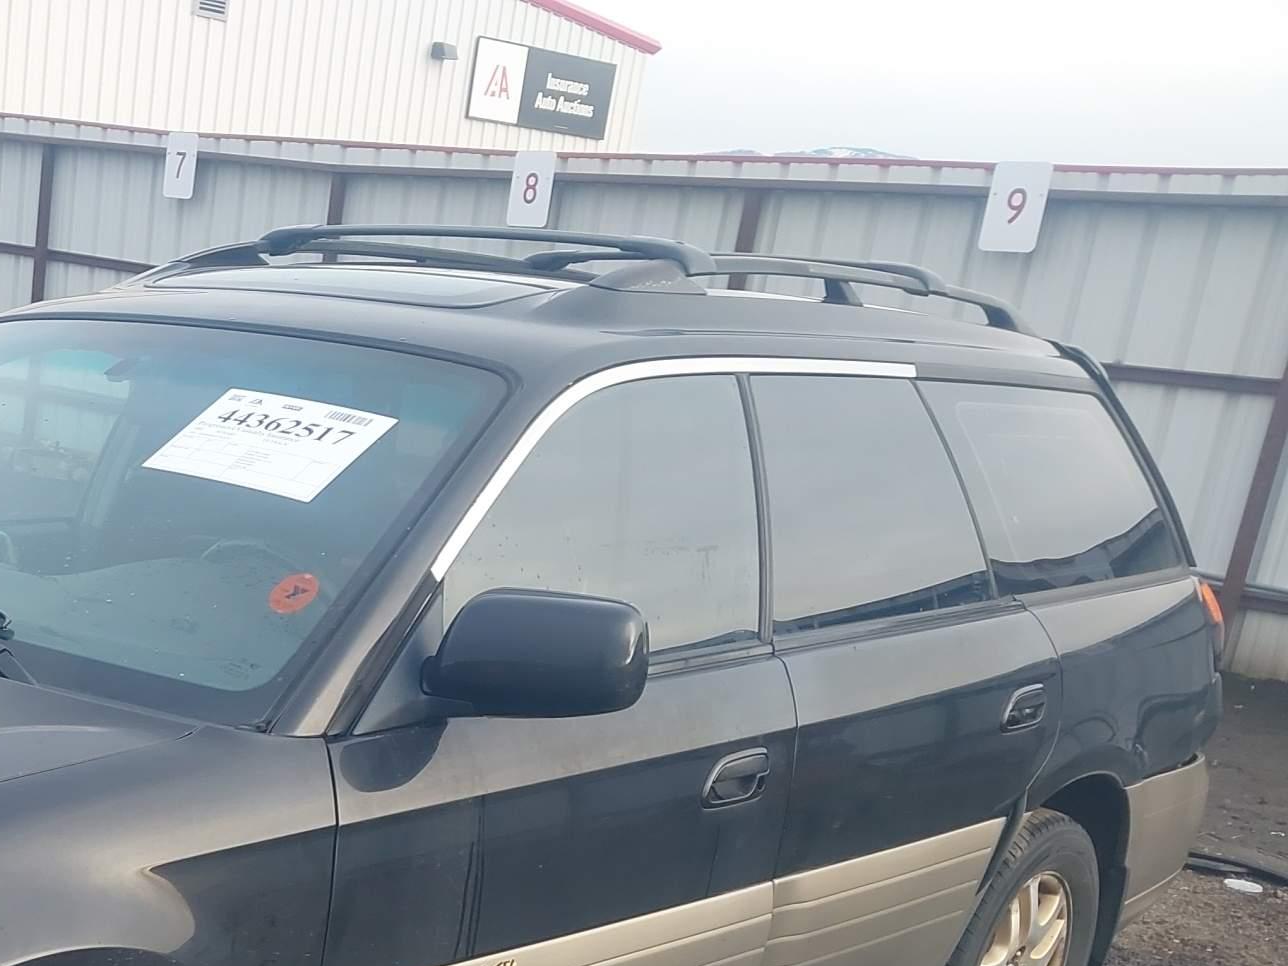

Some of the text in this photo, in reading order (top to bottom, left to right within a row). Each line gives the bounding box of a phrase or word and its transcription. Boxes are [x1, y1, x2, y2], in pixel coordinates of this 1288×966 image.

[546, 72, 590, 97] Insurance
[534, 92, 595, 118] Auto Auctions
[175, 151, 187, 179] 7
[523, 172, 539, 204] 8
[1007, 187, 1028, 225] 9
[217, 408, 356, 446] 44362517
